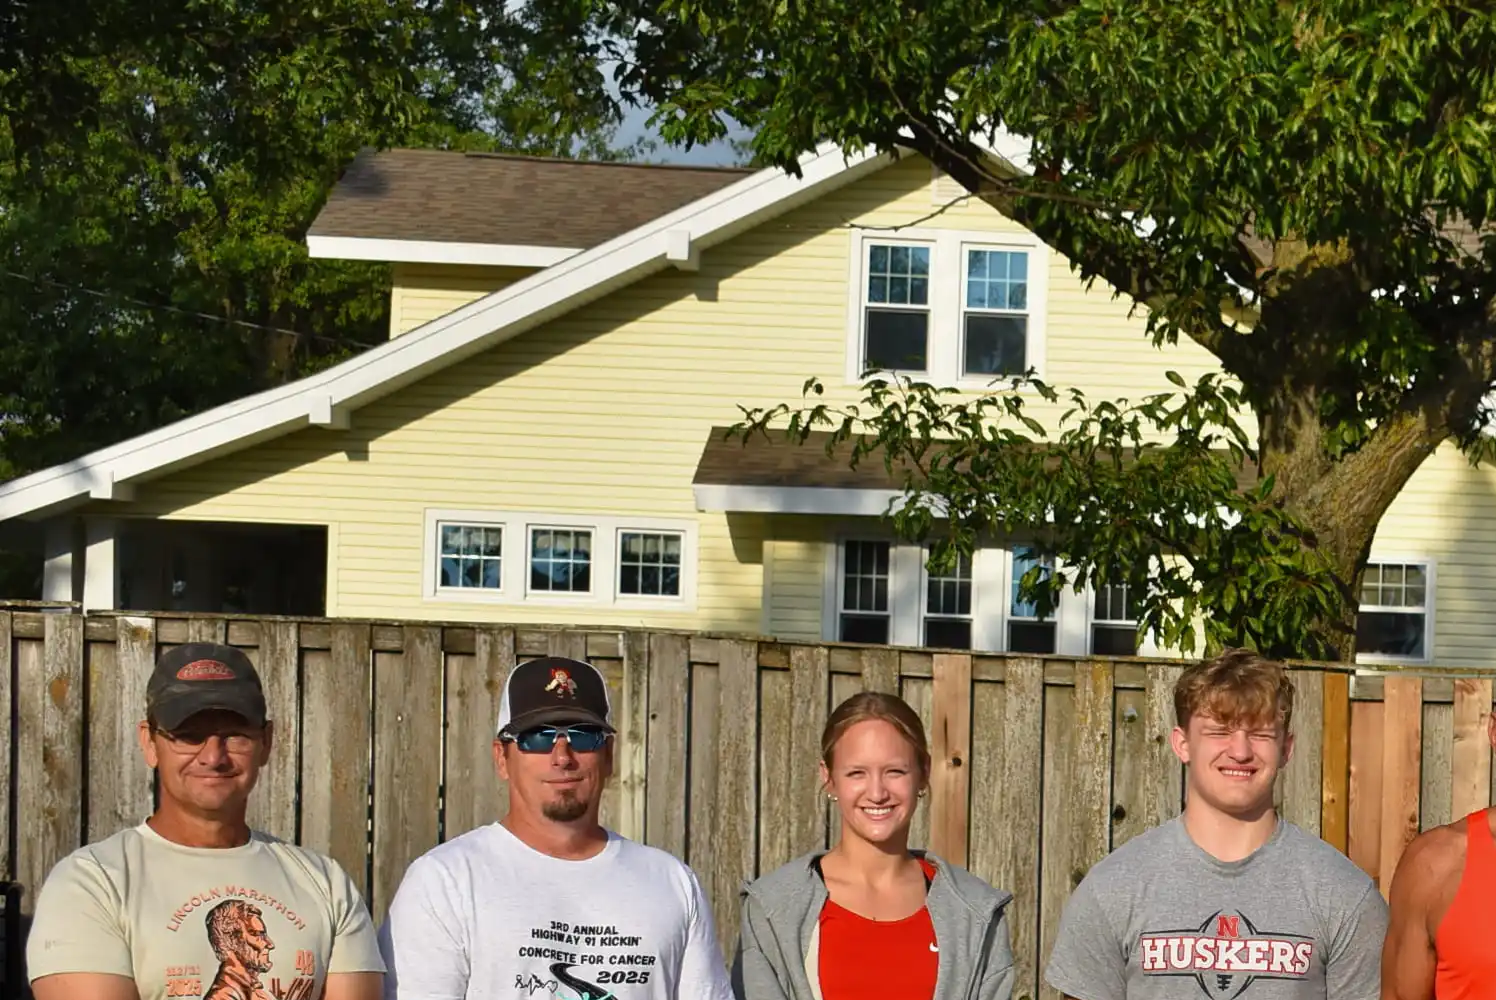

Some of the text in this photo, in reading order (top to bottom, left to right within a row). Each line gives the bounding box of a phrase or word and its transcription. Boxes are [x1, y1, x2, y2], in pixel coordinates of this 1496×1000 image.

[167, 885, 306, 932] LINCOLN MARATHON
[550, 921, 618, 934] 3RD ANNUAL
[1217, 916, 1239, 937] N
[532, 929, 580, 944] HIGHWAY
[585, 936, 596, 946] 91
[519, 947, 656, 965] CONCRETE FOR CANCER
[1142, 937, 1312, 975] HUSKERS
[596, 970, 650, 984] 2025
